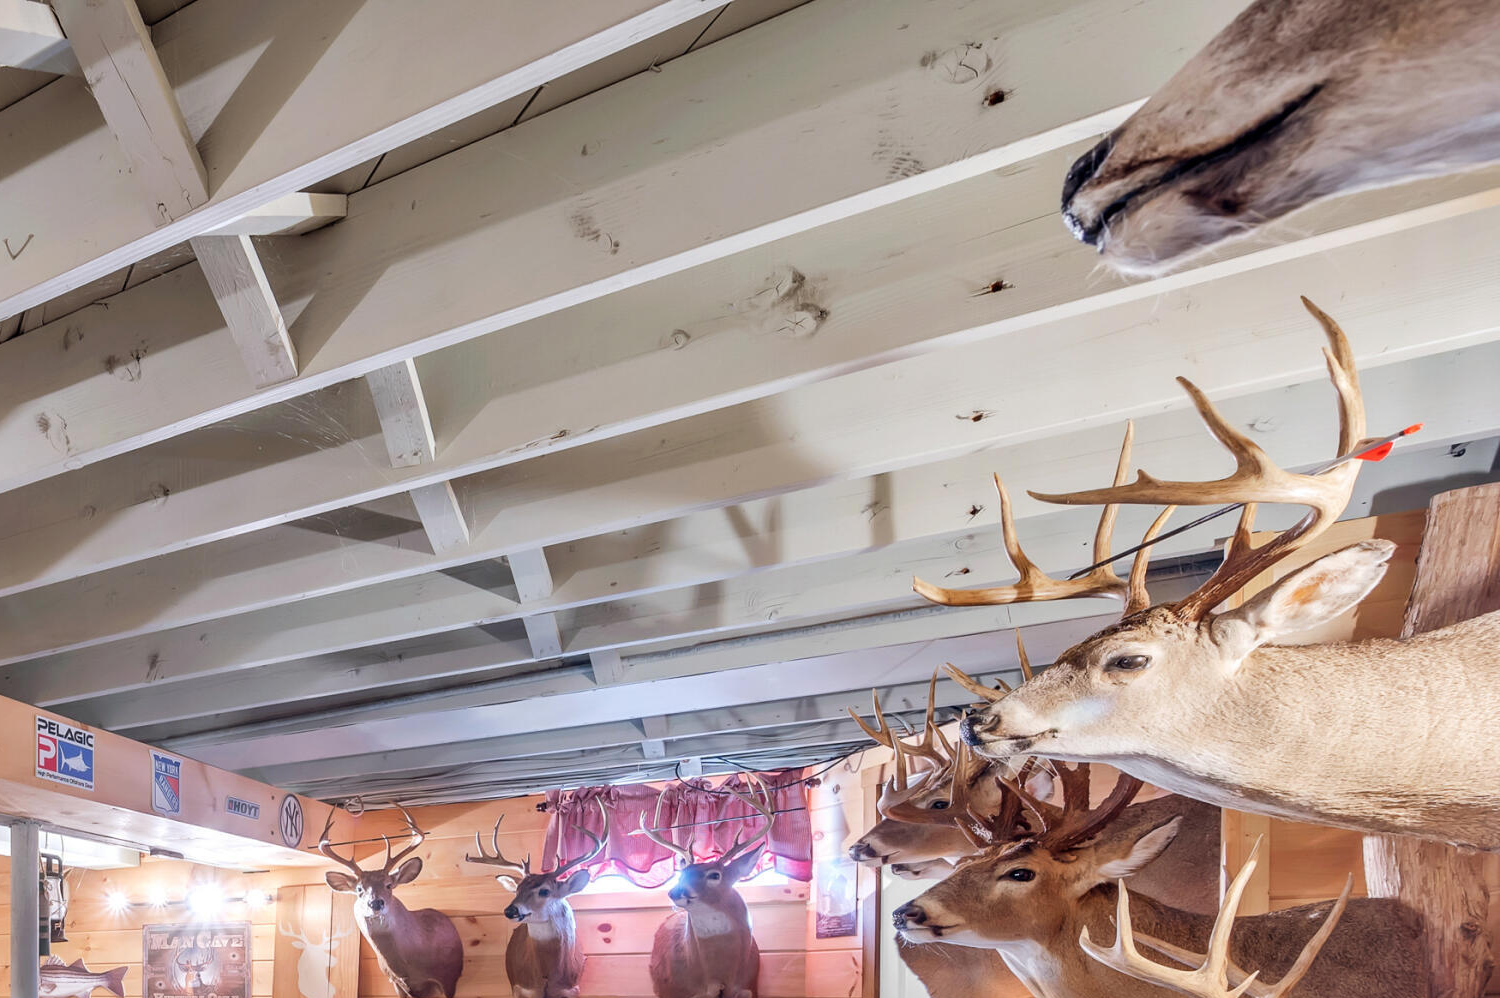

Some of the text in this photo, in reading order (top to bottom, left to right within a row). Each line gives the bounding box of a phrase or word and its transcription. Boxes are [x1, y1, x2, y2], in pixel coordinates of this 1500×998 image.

[37, 717, 94, 748] PELAGIC
[155, 760, 179, 776] NEW YORK
[158, 773, 180, 812] RANGERS
[233, 801, 260, 817] HOYT
[149, 930, 245, 951] MAN CAVE
